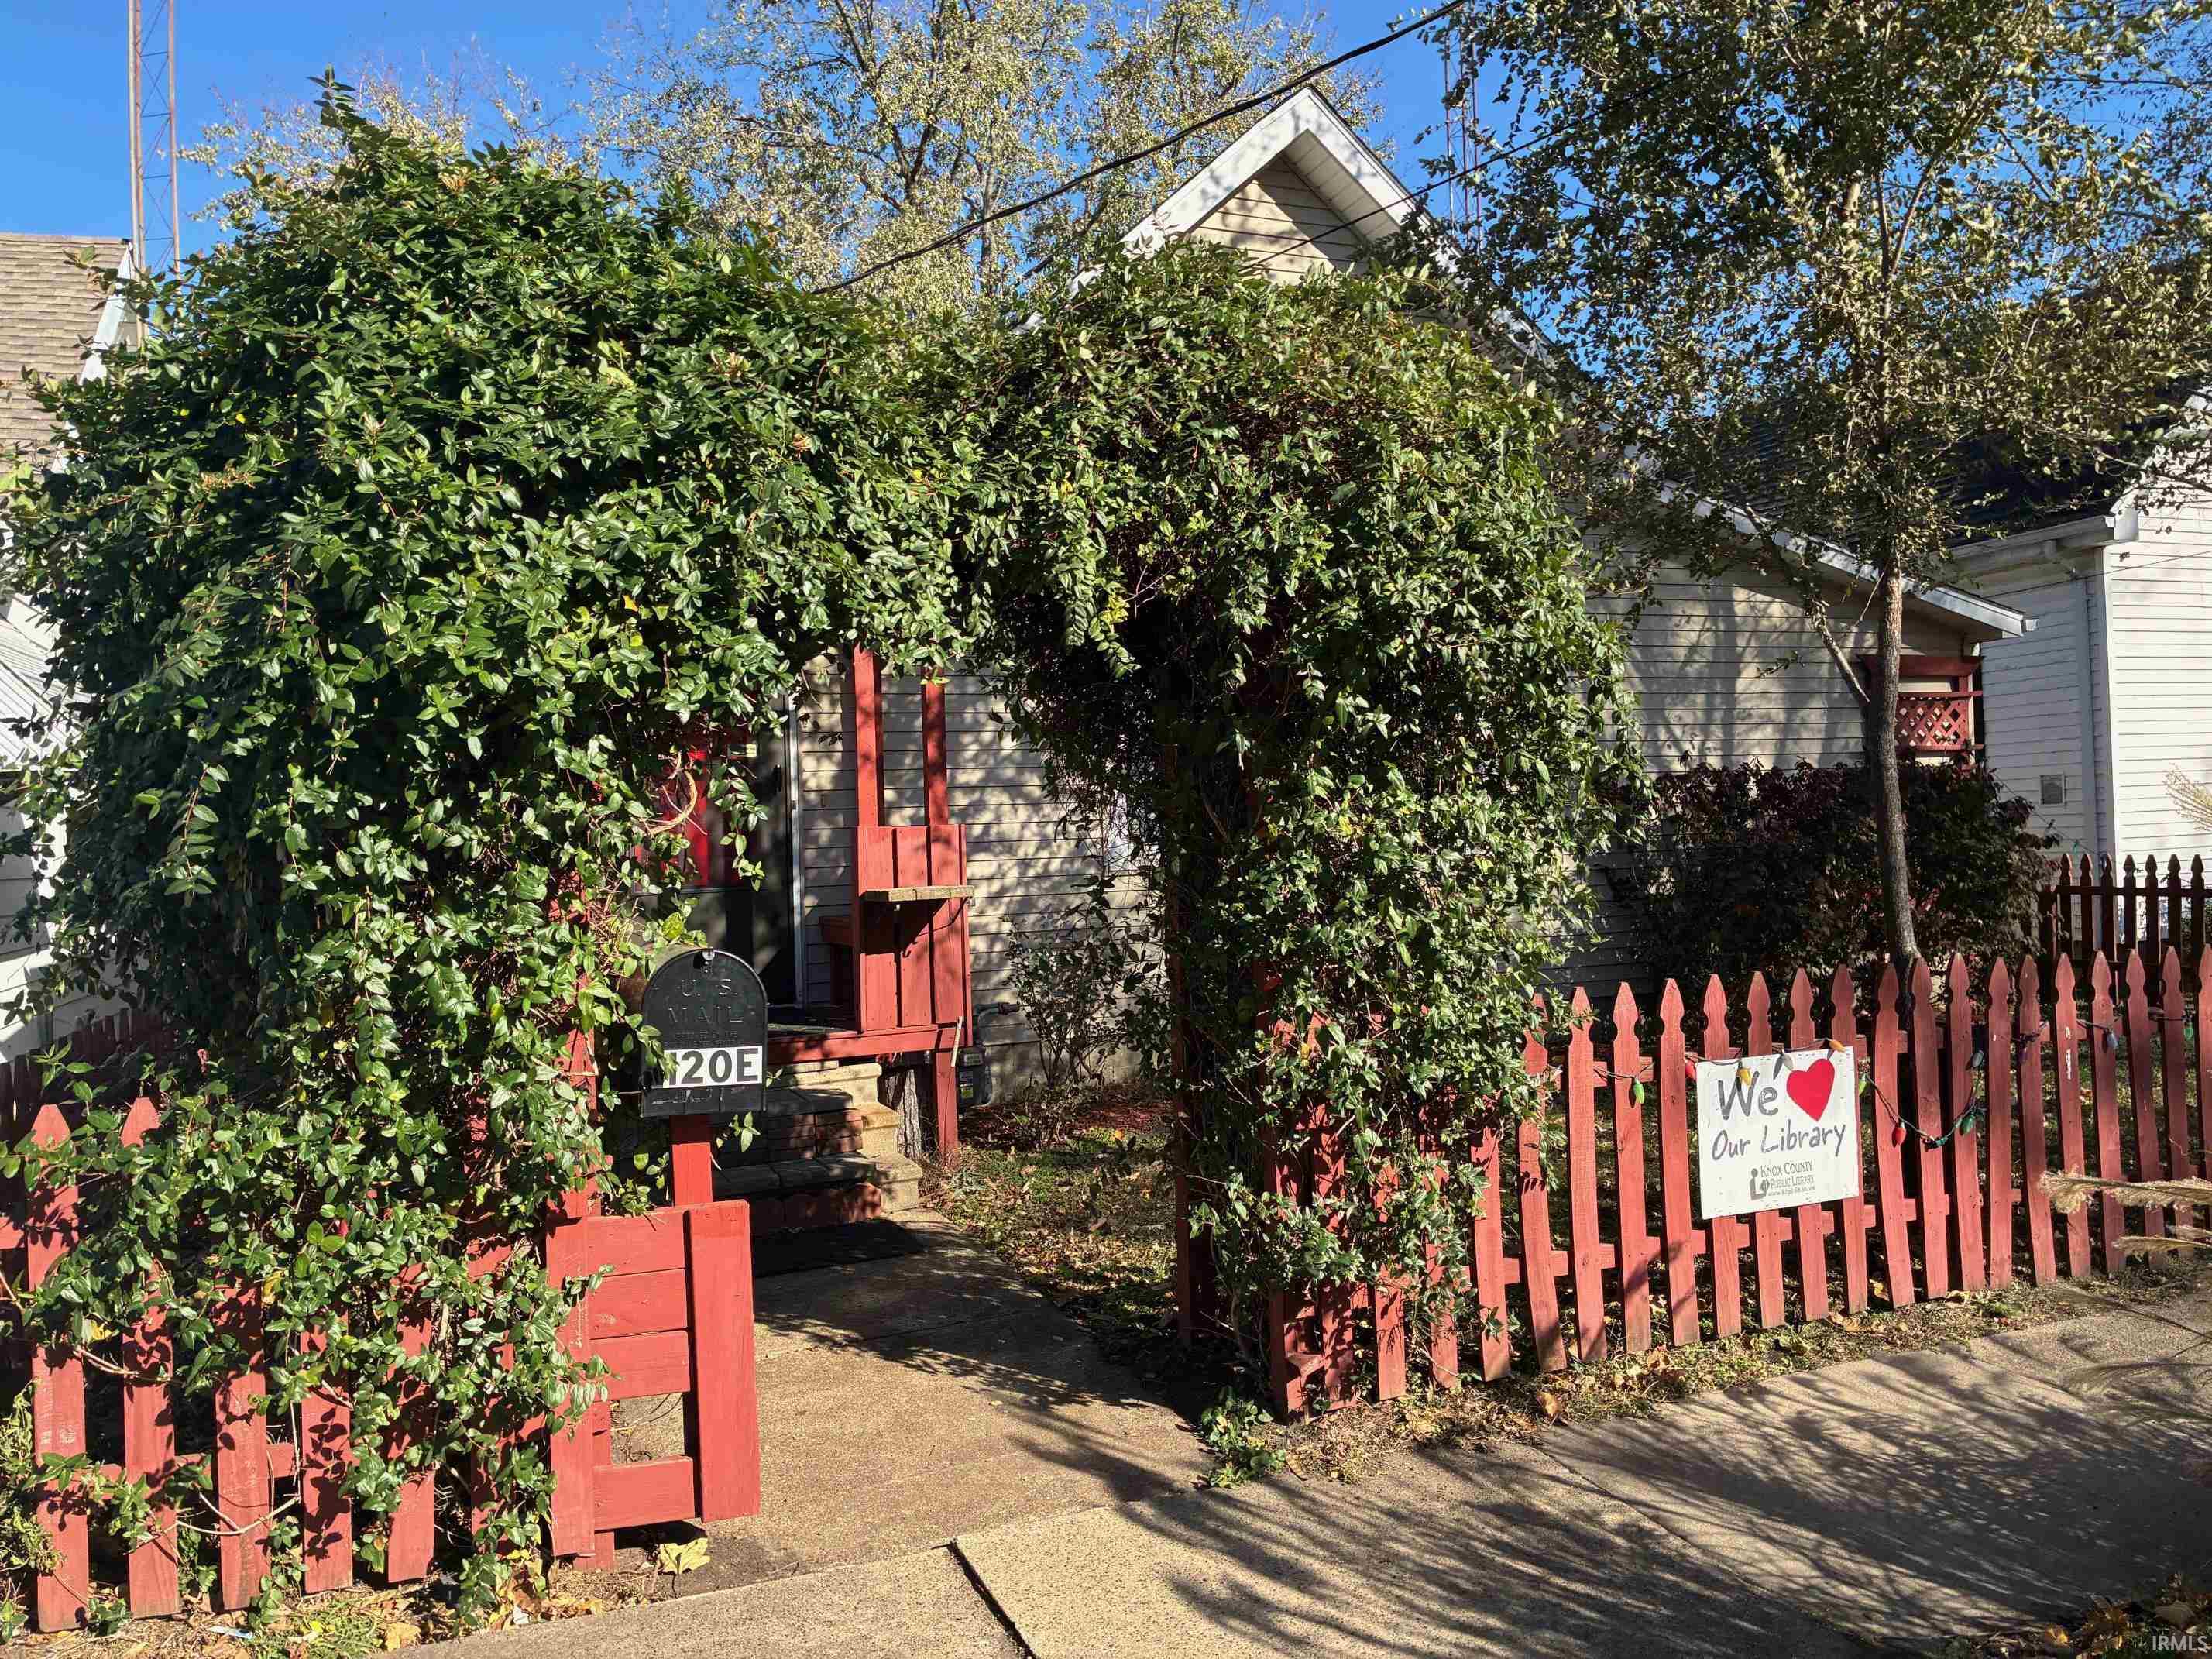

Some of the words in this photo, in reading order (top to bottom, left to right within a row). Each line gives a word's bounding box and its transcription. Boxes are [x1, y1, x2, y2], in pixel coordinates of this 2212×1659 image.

[665, 1005, 744, 1023] MAIL
[1717, 1070, 1779, 1121] We
[1712, 1129, 1751, 1161] Our
[1760, 1118, 1846, 1157] Library
[1760, 1164, 1783, 1177] KNOX
[1784, 1160, 1813, 1175] COUNTY
